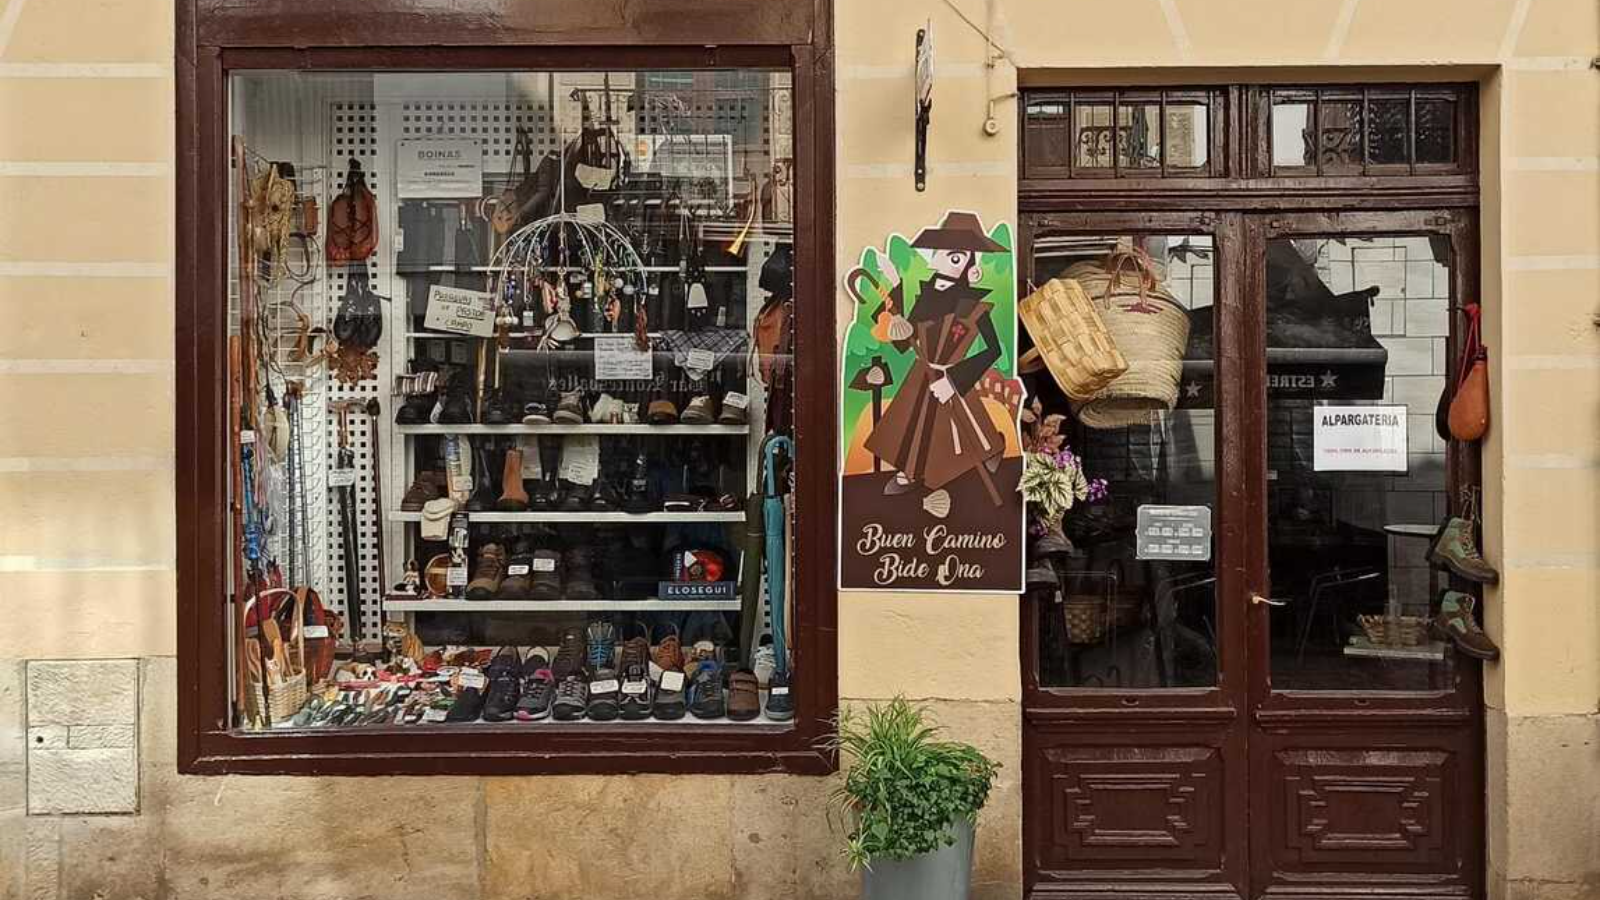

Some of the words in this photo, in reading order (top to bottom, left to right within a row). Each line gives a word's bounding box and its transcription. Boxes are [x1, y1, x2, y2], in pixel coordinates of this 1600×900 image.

[1321, 413, 1399, 426] ALPARGATERIA
[857, 523, 915, 556] Buen
[923, 524, 1006, 555] Camino
[874, 553, 929, 585] Bide
[936, 555, 984, 586] Ona
[667, 586, 726, 595] ELOSEGUI
